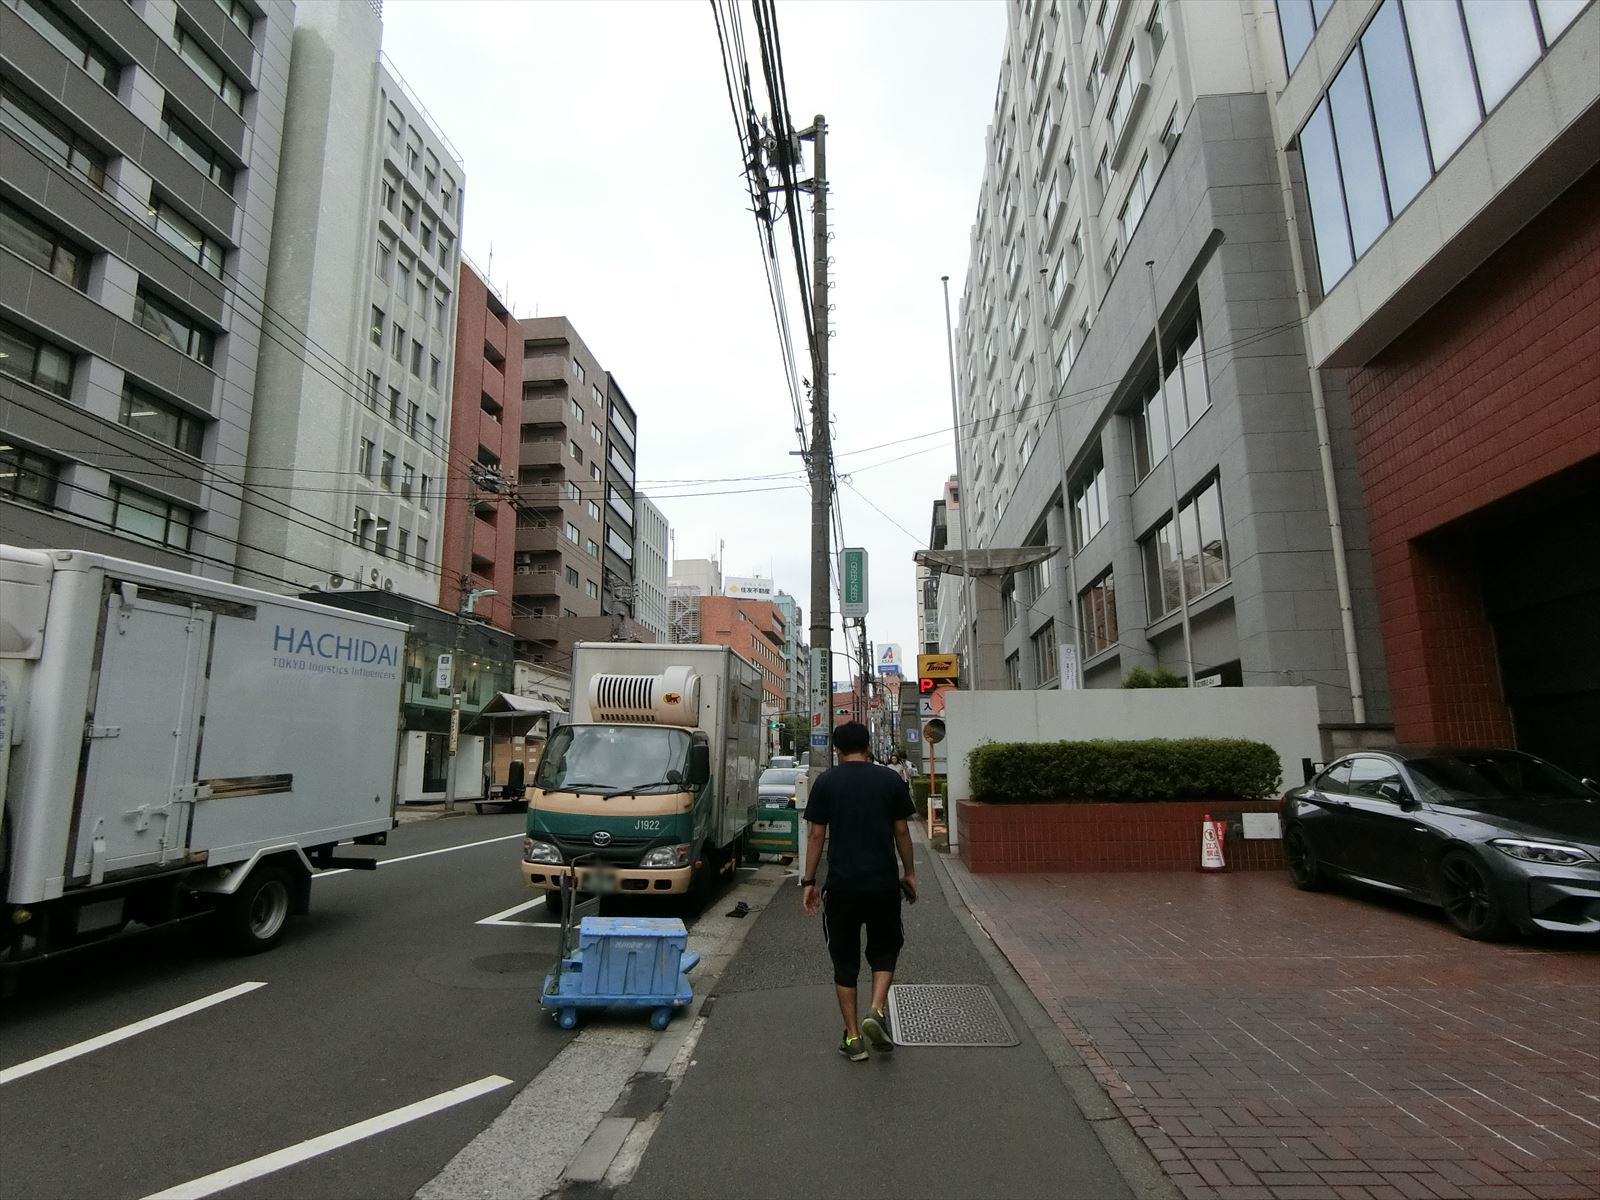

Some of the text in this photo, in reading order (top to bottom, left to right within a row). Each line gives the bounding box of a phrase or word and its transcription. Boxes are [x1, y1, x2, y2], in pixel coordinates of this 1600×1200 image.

[850, 561, 858, 584] GREEN
[850, 584, 858, 602] SEED
[273, 625, 398, 667] HACHIDAI
[272, 657, 306, 671] TOKYO
[309, 662, 349, 676] logistics
[926, 661, 952, 672] Times
[920, 678, 934, 693] P
[923, 702, 933, 711] 入
[634, 819, 660, 831] J1922
